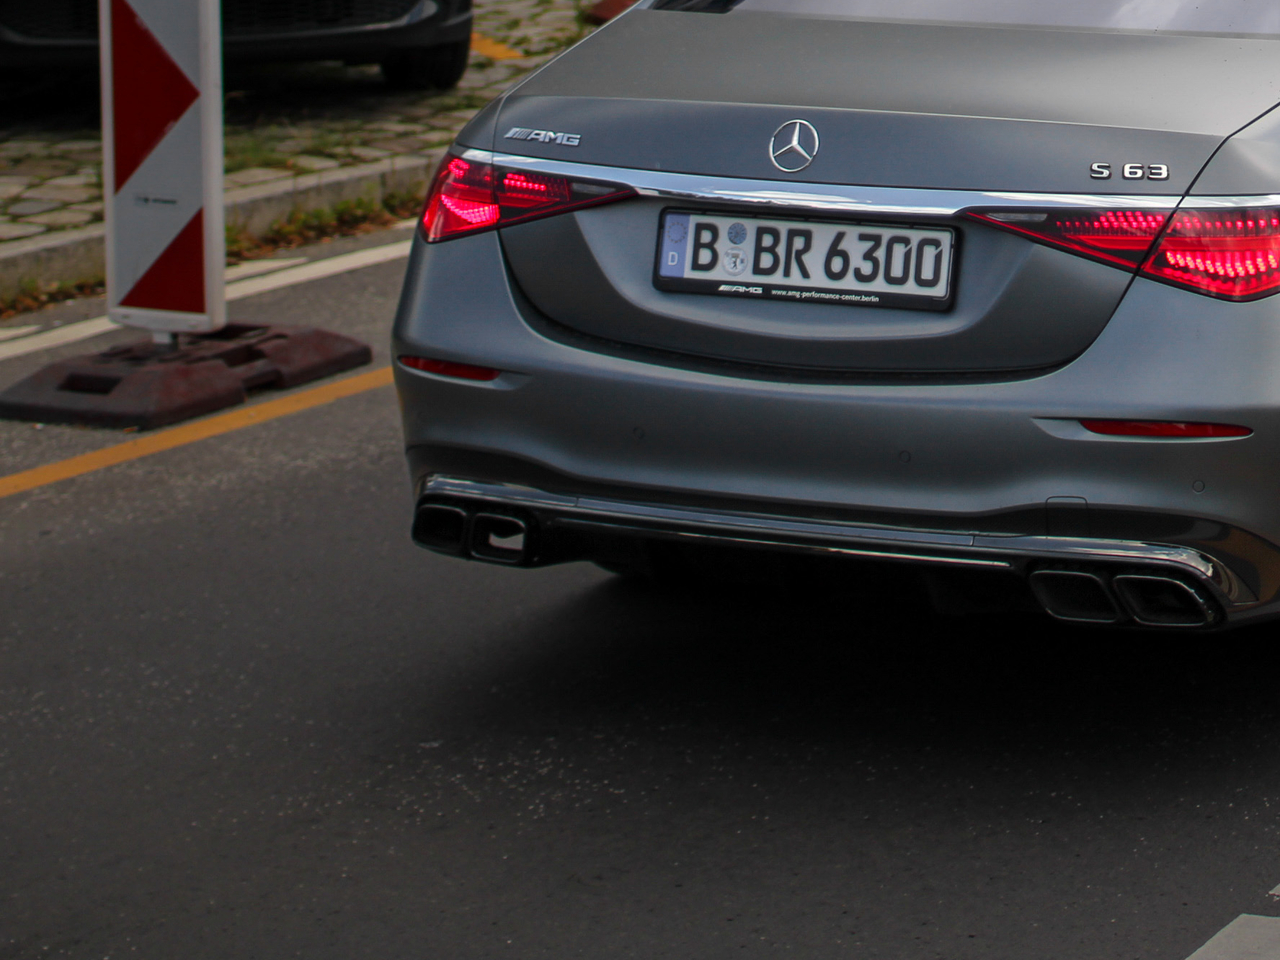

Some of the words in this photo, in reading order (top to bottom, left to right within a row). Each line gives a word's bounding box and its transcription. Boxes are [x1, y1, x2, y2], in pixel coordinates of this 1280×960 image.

[526, 129, 582, 147] AMG
[1090, 162, 1111, 180] S
[1122, 163, 1169, 181] 63
[667, 251, 679, 266] D
[691, 222, 720, 272] B
[752, 226, 813, 280] BR
[824, 231, 943, 288] 6300
[731, 285, 763, 294] AMG
[771, 289, 880, 302] www.amg-performance-center.berlin
